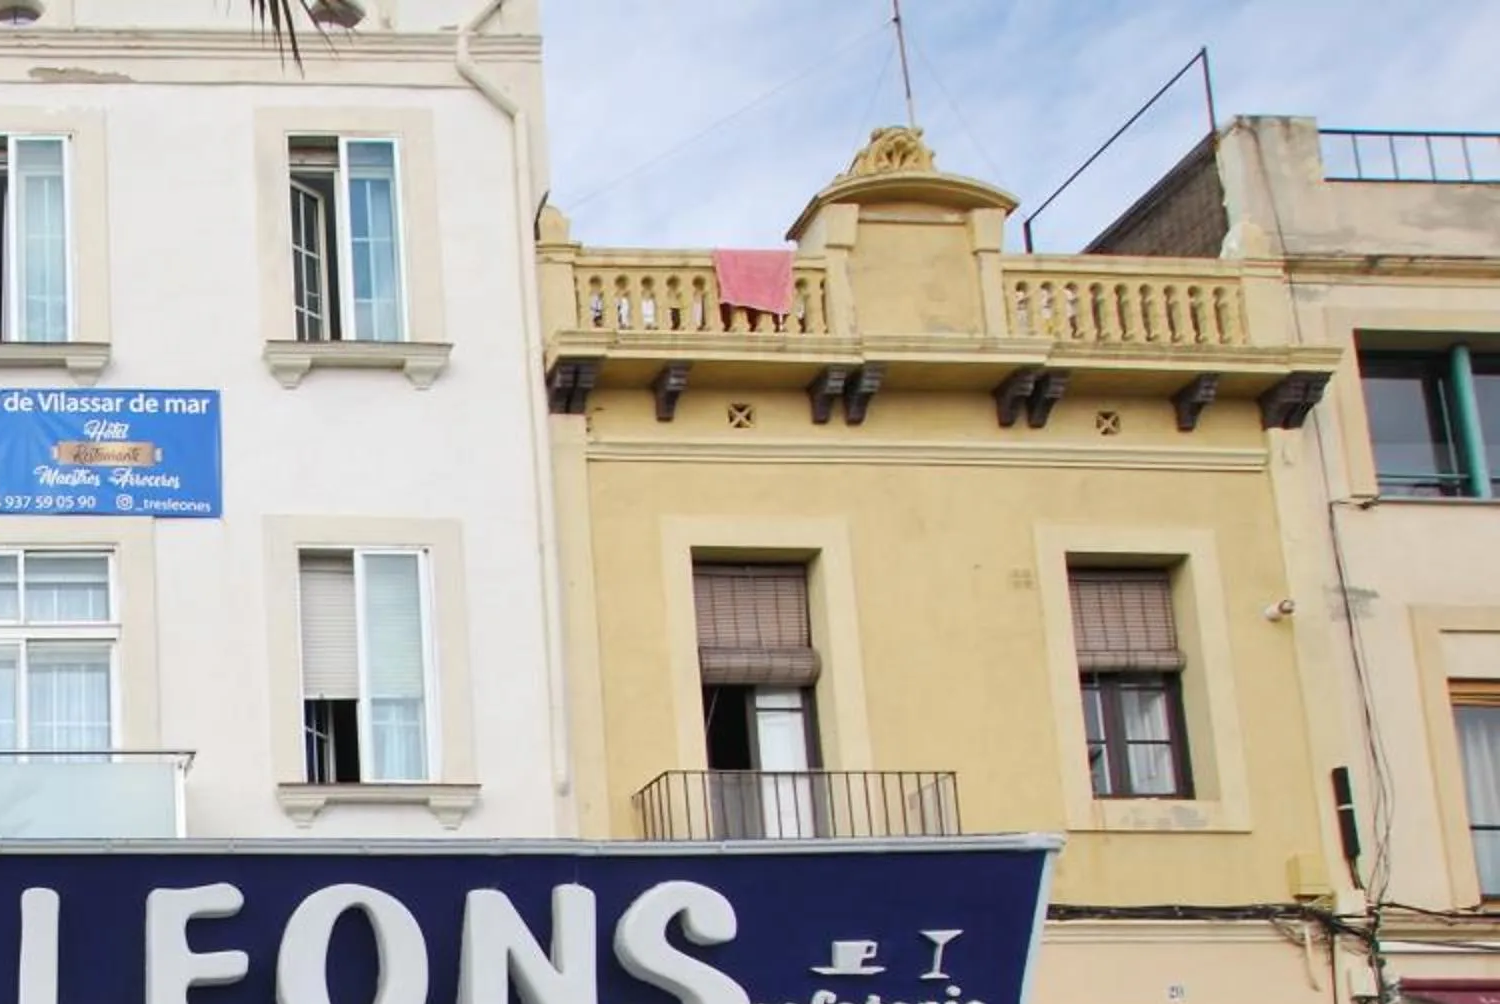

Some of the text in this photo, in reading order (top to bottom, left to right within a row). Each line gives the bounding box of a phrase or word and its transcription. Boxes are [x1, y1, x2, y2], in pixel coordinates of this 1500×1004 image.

[3, 391, 33, 412] de
[38, 391, 124, 413] Vilassar
[129, 392, 159, 413] de
[164, 397, 210, 414] mar
[5, 496, 96, 510] 937 59 05 90
